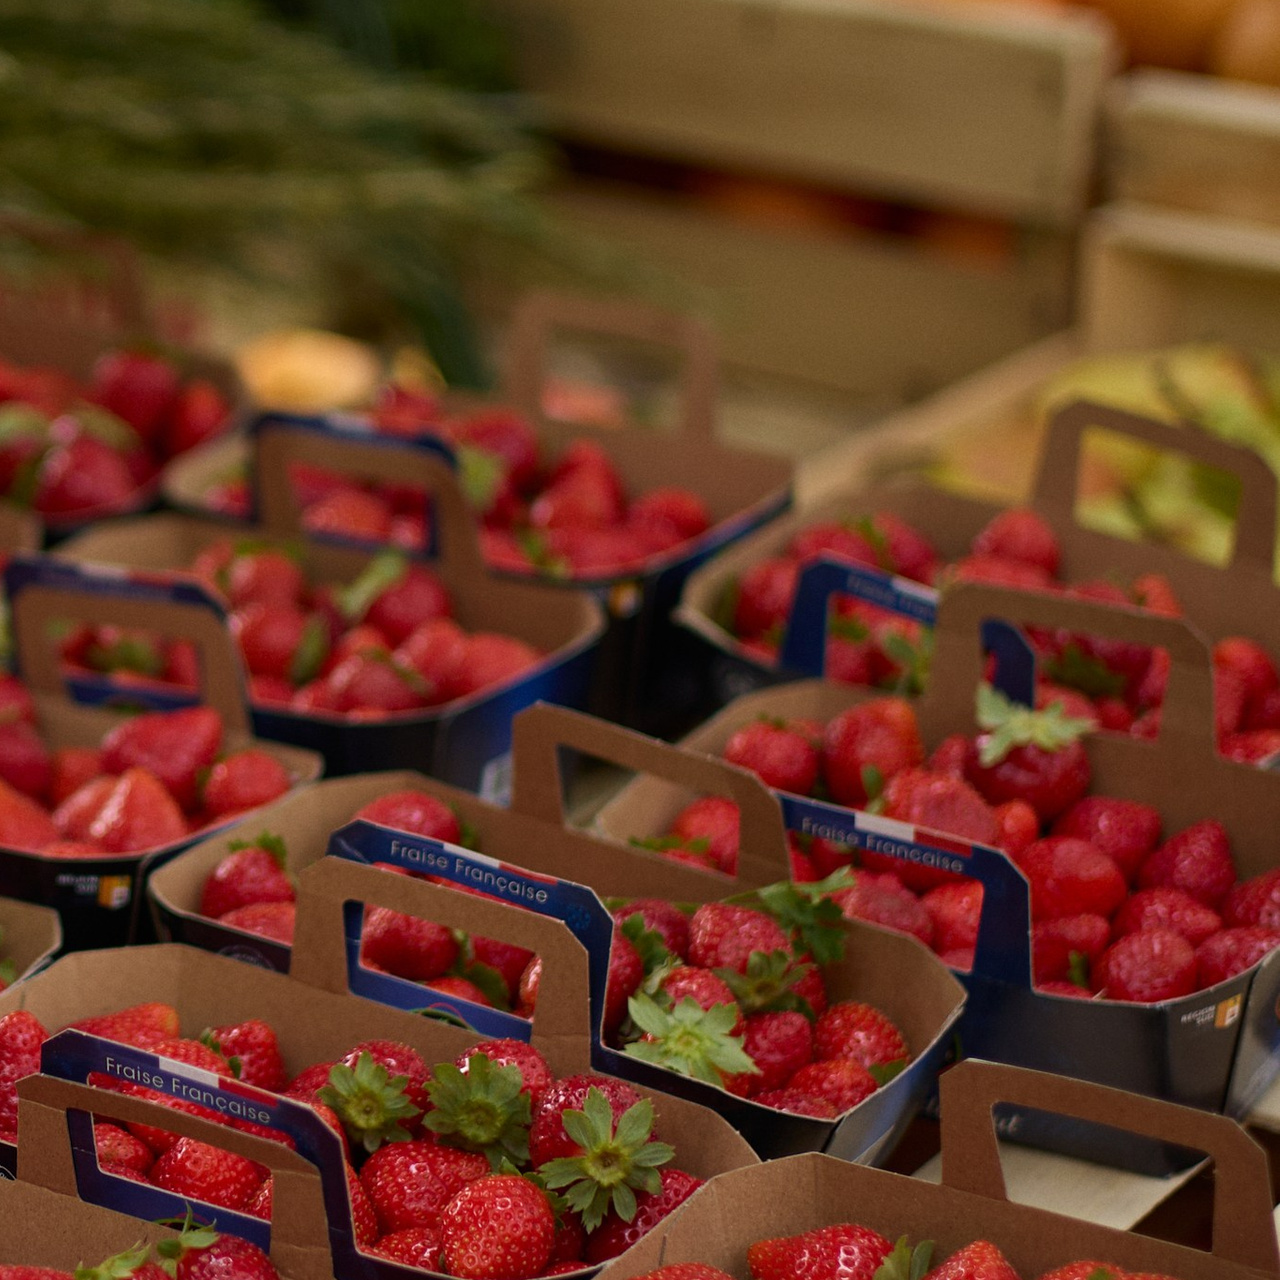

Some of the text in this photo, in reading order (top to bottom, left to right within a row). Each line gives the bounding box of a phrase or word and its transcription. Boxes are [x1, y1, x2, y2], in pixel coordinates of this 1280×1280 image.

[801, 816, 860, 845] Fraise
[390, 840, 548, 904] Fraise Française
[106, 1056, 271, 1125] Fraise Française
